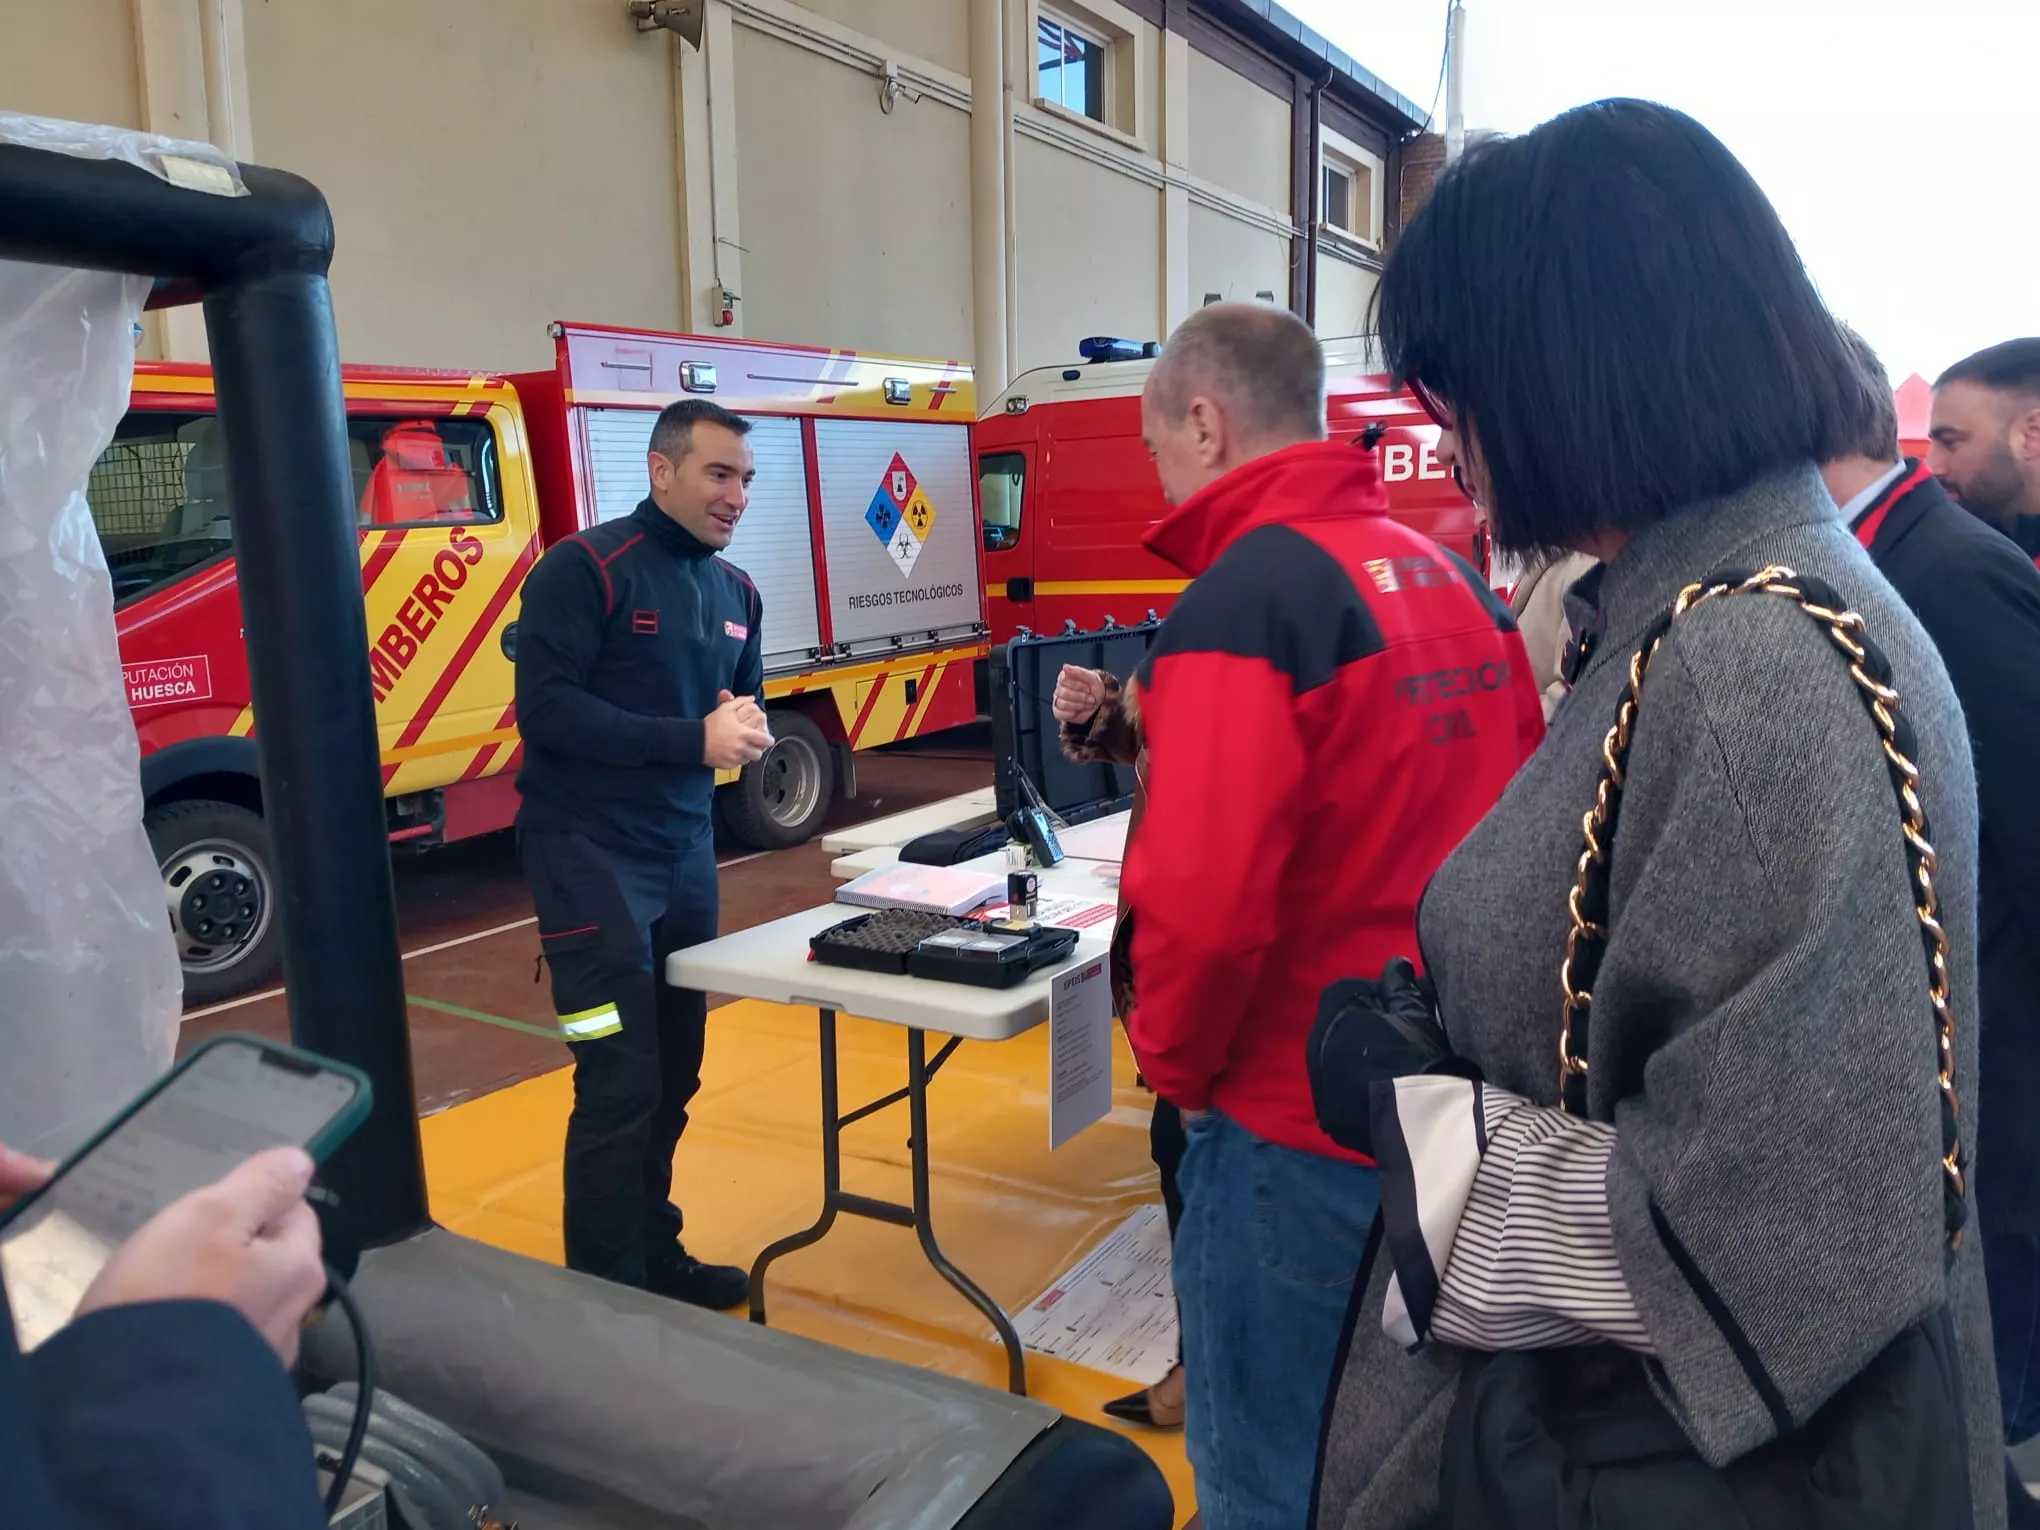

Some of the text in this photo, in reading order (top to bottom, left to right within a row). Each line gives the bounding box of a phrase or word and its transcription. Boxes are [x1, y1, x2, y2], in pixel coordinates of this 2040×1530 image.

[1384, 443, 1454, 482] BE
[849, 583, 963, 609] RIESGOS TECNOLÓGICOS
[131, 680, 196, 701] HUESCA
